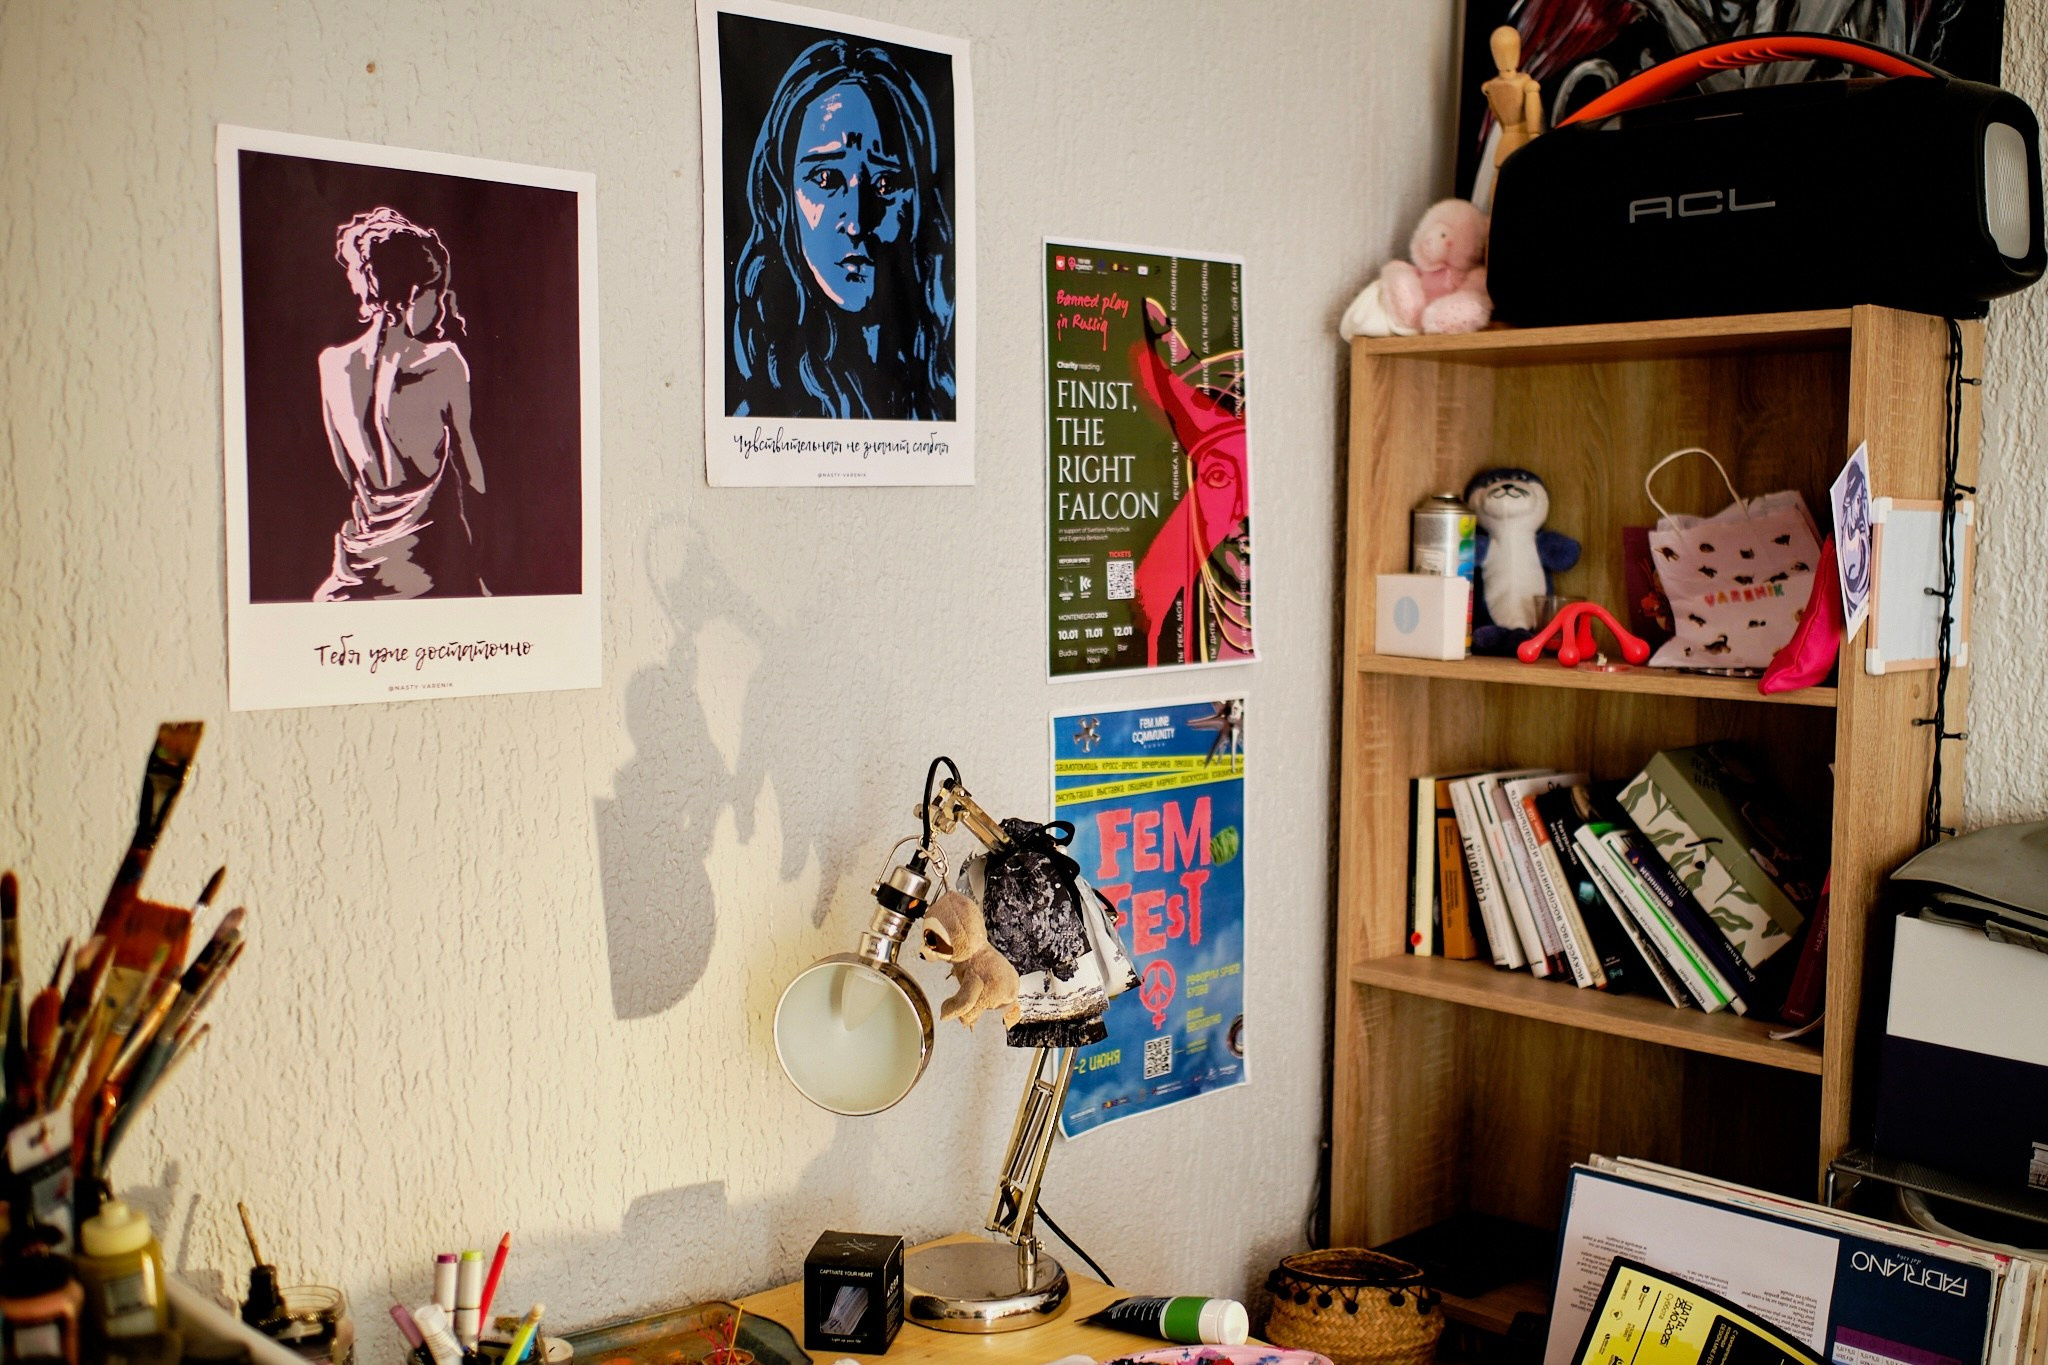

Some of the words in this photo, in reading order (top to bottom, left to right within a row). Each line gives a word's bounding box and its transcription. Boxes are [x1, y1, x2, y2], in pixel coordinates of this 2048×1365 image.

[1629, 188, 1776, 224] ACL
[1057, 290, 1099, 307] Banned
[1102, 293, 1129, 318] play
[1057, 314, 1068, 340] in
[1057, 379, 1137, 412] FINIST,
[1056, 417, 1105, 446] THE
[846, 441, 861, 452] не
[1058, 455, 1136, 484] RIGHT
[1058, 491, 1160, 521] FALCON
[1108, 550, 1132, 558] TICKETS
[1058, 630, 1078, 640] 10.01
[1085, 628, 1103, 638] 11.01
[1113, 626, 1133, 637] 12.01
[313, 633, 361, 667] Тебя
[368, 647, 409, 674] уже
[416, 639, 534, 671] достаточно
[1058, 650, 1078, 658] Budva
[1117, 644, 1128, 652] Bar
[1132, 728, 1175, 744] COMMUNITY
[1096, 796, 1212, 880] FEM
[1638, 863, 1677, 909] ФЕМИНИЗМ
[1089, 1049, 1121, 1071] ИЮНЯ
[820, 1268, 843, 1276] CAPTIVATE
[1849, 1249, 1969, 1297] FABRIANO
[1657, 1292, 1673, 1320] Суббота
